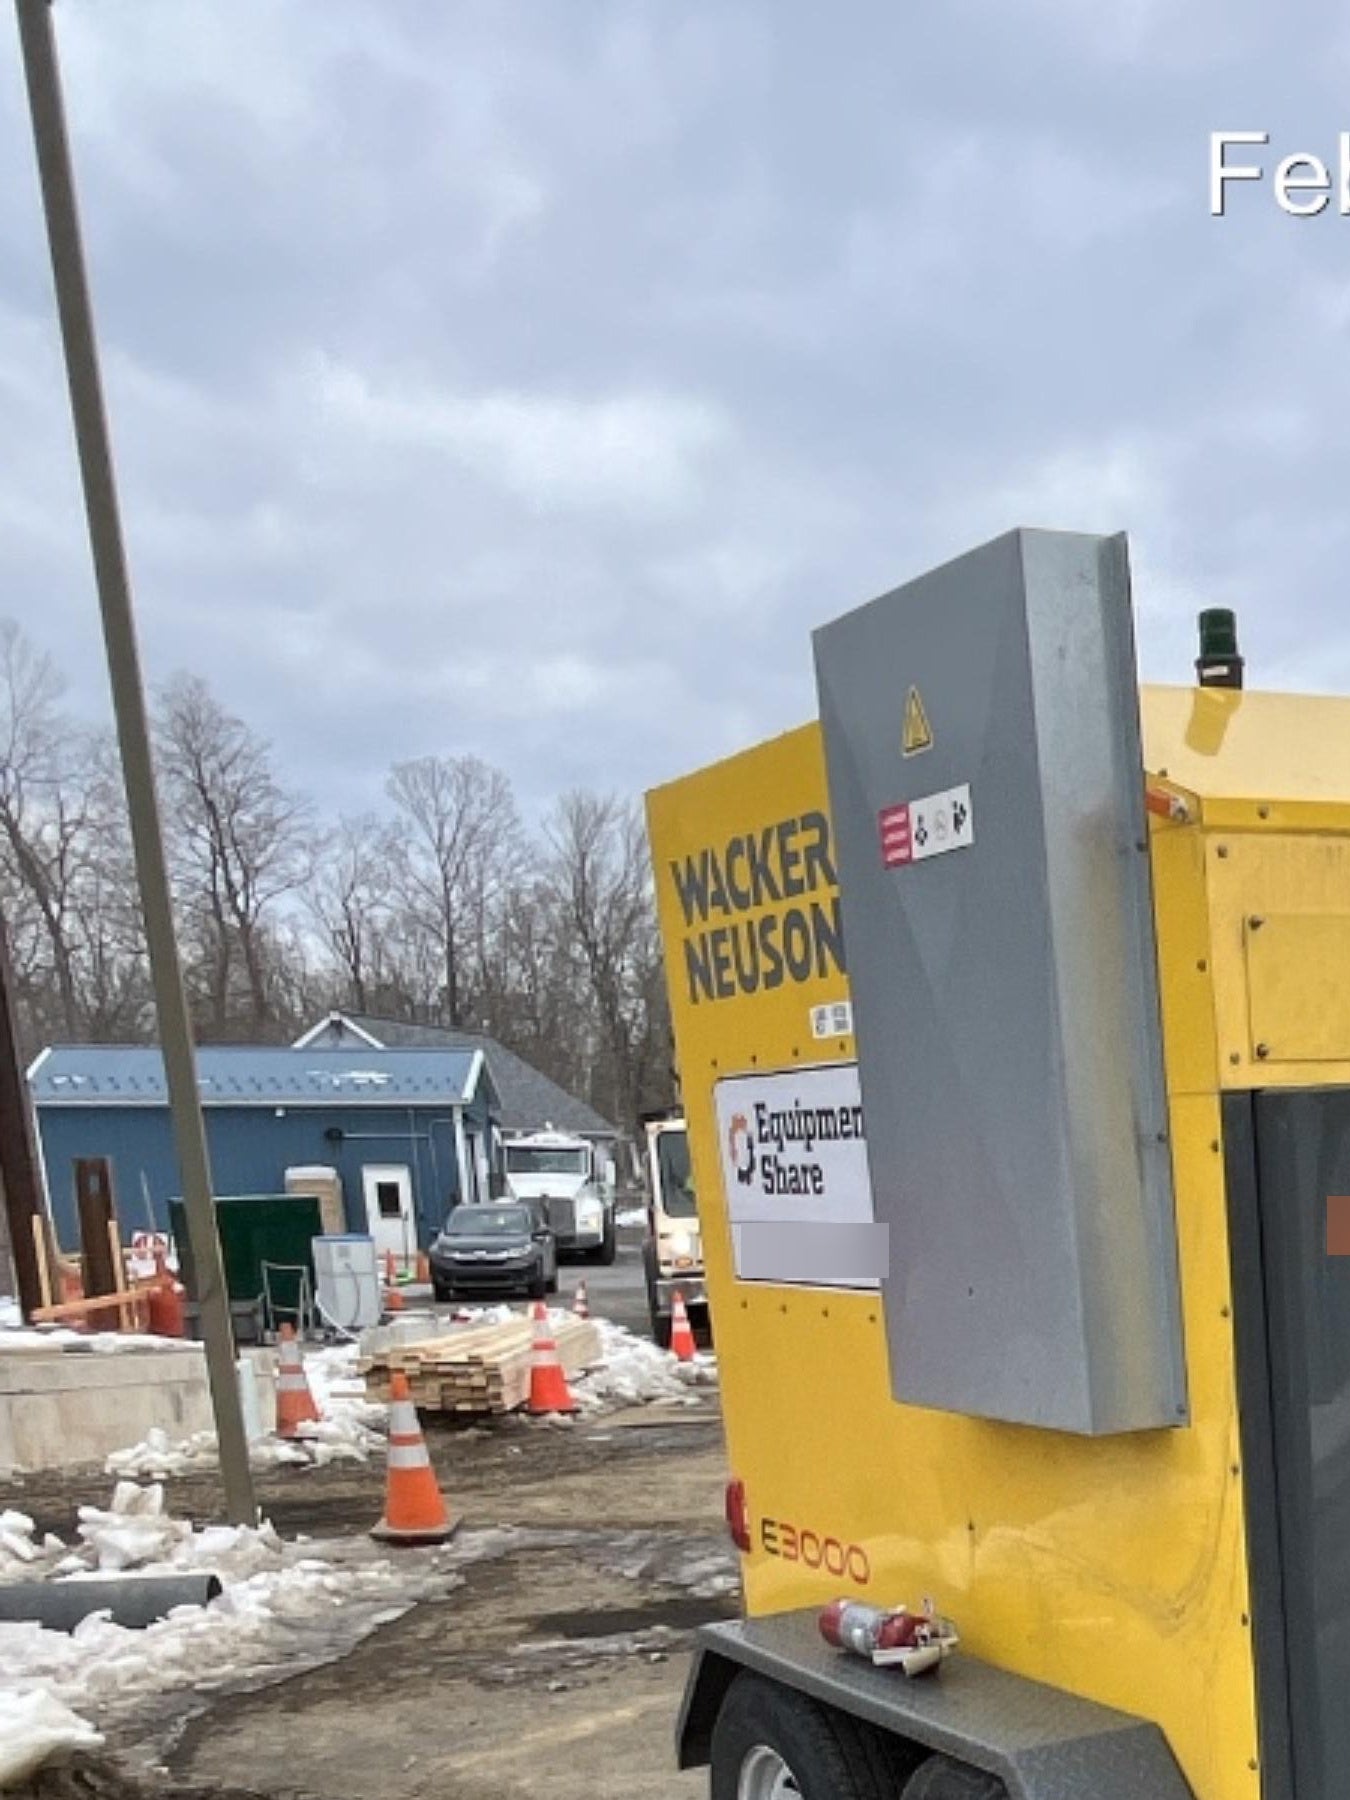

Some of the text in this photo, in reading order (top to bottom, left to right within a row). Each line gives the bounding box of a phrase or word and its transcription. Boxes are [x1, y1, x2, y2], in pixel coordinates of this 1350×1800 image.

[669, 811, 839, 928] WACKER
[683, 897, 850, 1005] NEUSON
[754, 1098, 867, 1152] Equipmen
[761, 1154, 825, 1195] Share
[761, 1517, 871, 1585] E3000
